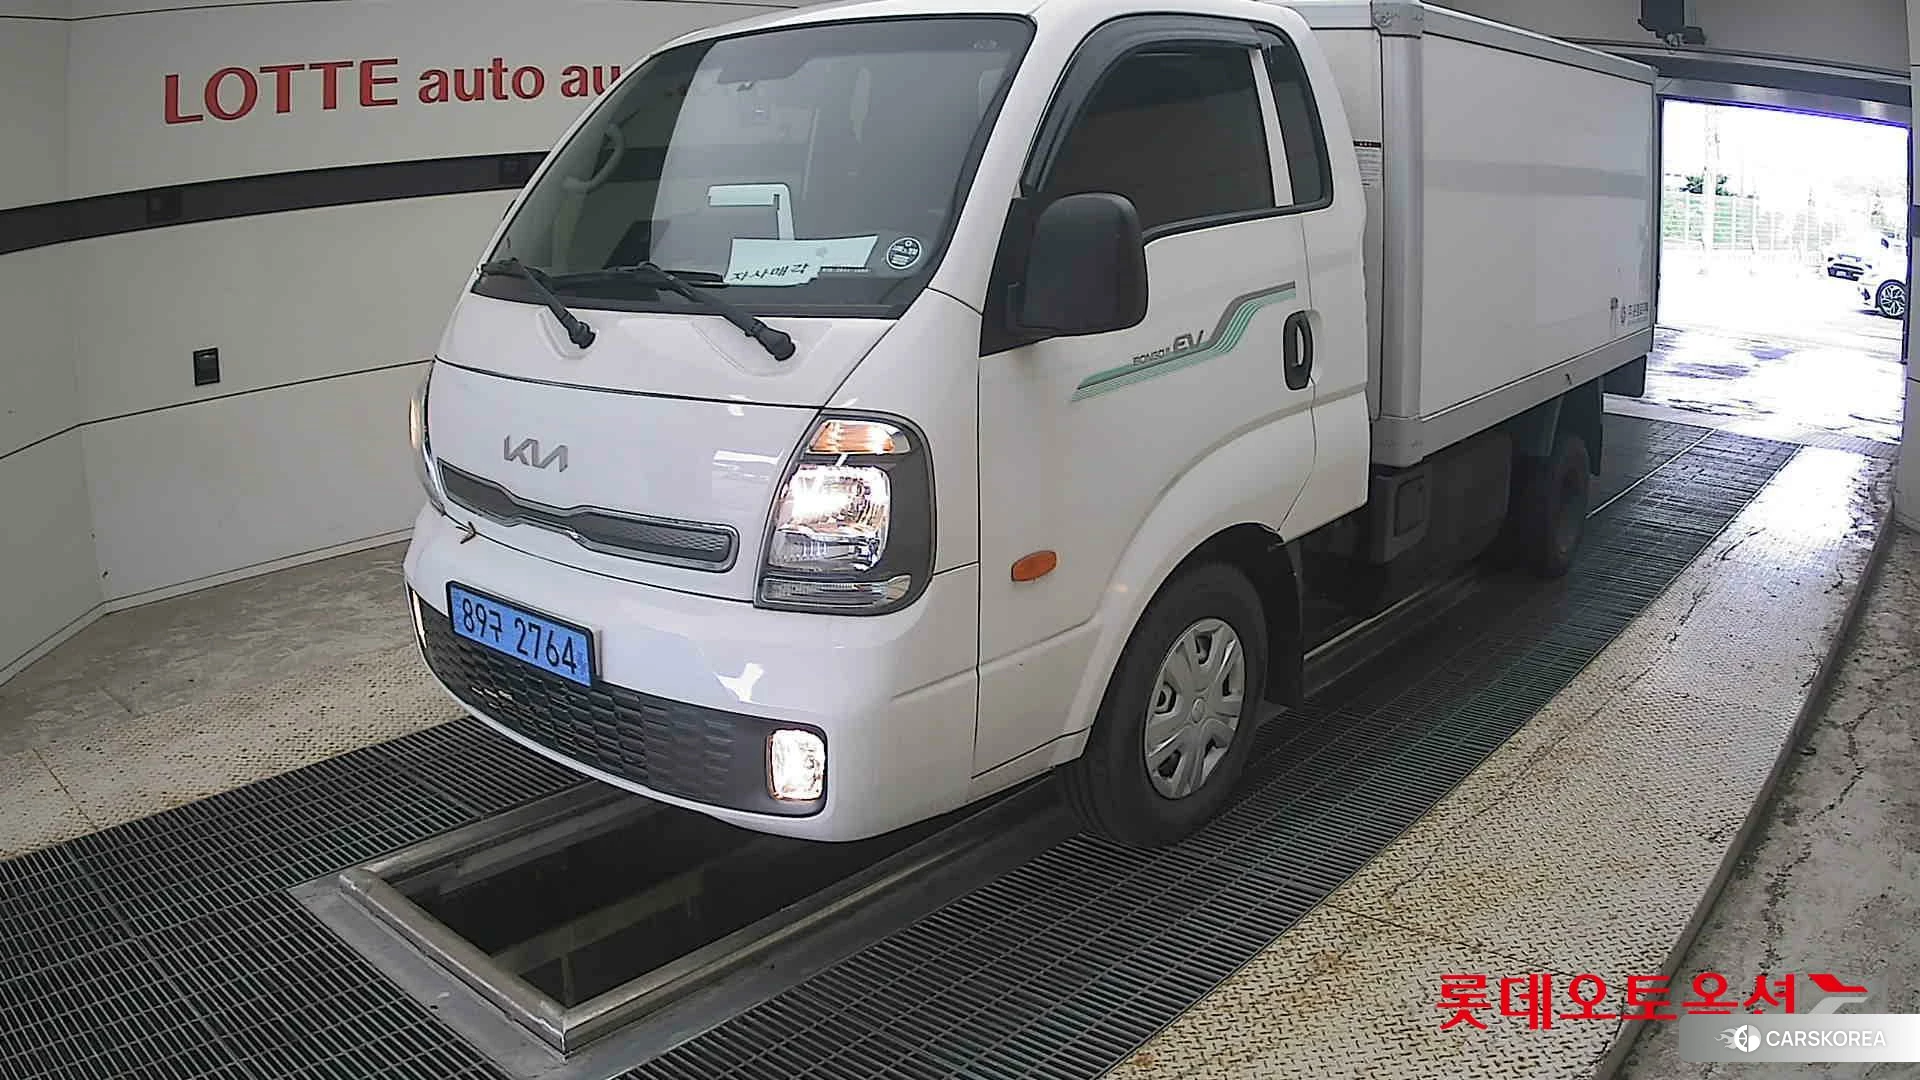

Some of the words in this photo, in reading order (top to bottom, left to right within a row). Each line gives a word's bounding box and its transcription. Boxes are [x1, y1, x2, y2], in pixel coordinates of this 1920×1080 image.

[164, 57, 399, 125] LOTTE
[418, 57, 545, 104] auto
[1172, 329, 1205, 353] EV
[504, 434, 569, 473] KIA
[514, 616, 578, 675] 2764
